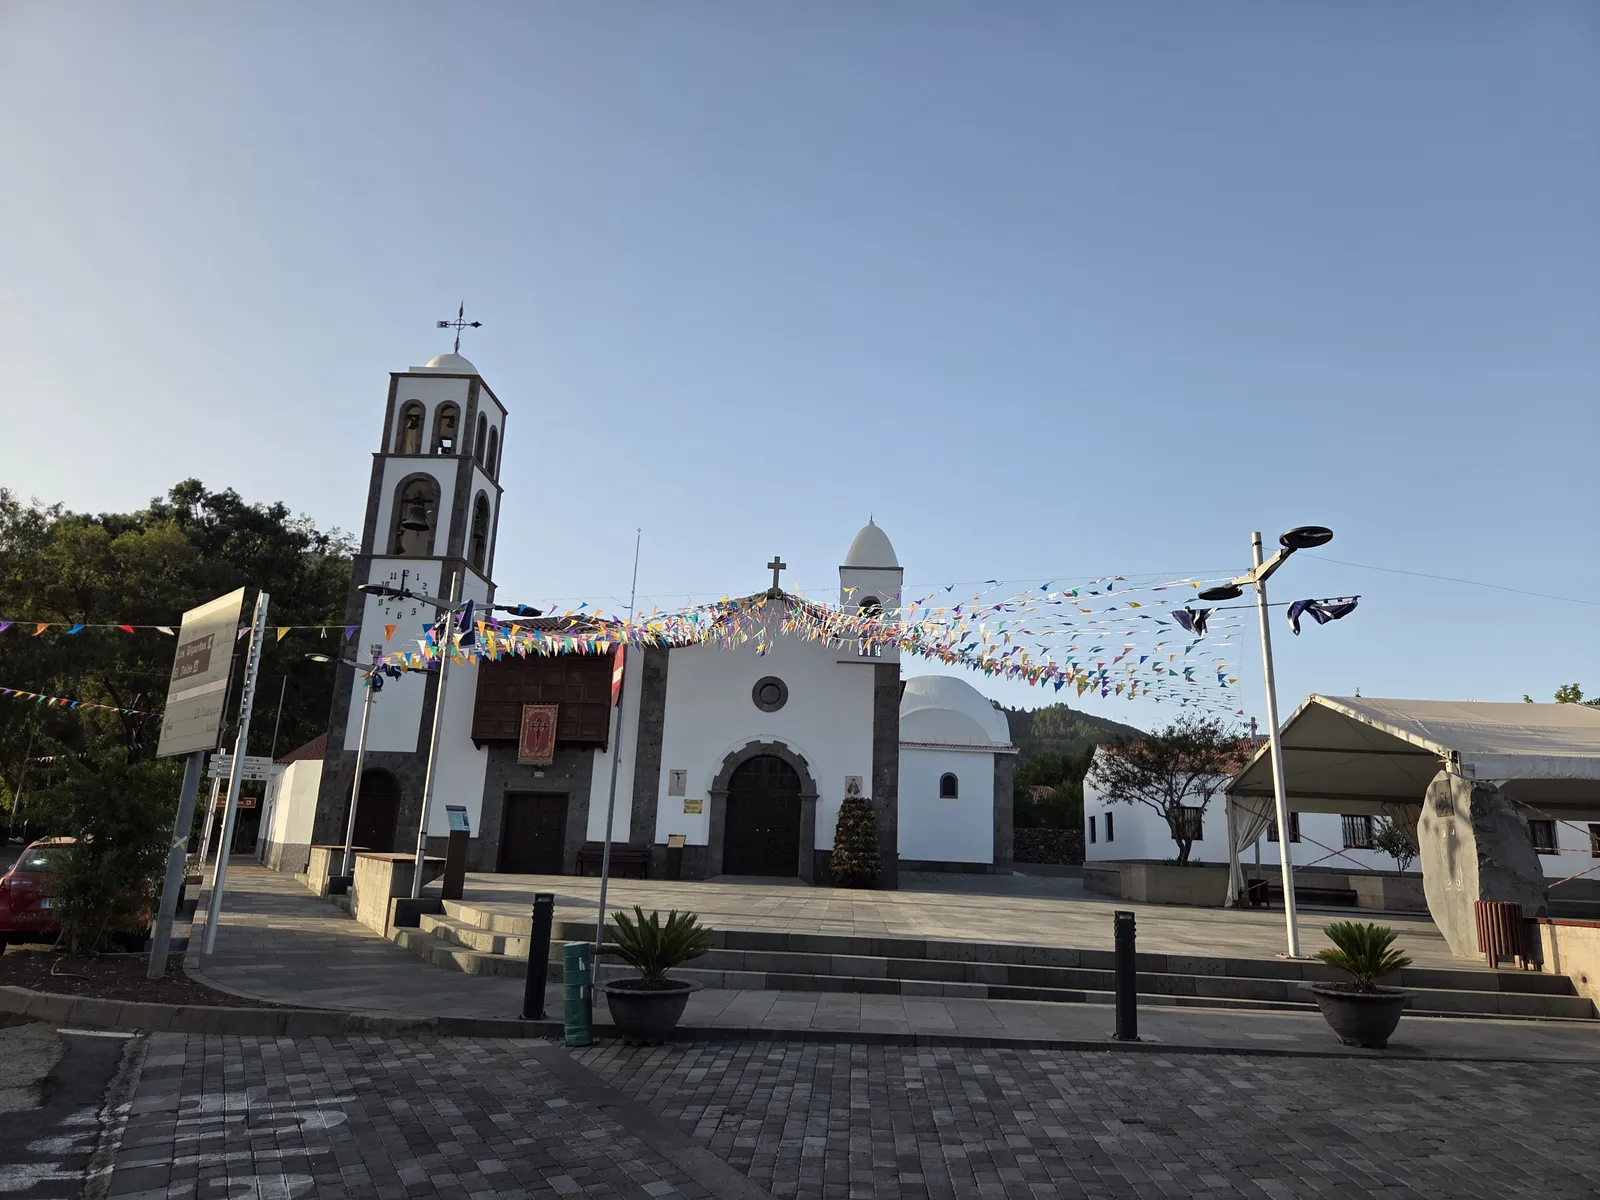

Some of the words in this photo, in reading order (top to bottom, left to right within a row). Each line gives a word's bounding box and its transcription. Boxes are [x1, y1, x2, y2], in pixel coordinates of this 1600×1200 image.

[390, 572, 397, 580] 11
[186, 641, 207, 657] Gigantes
[181, 664, 192, 676] Teide
